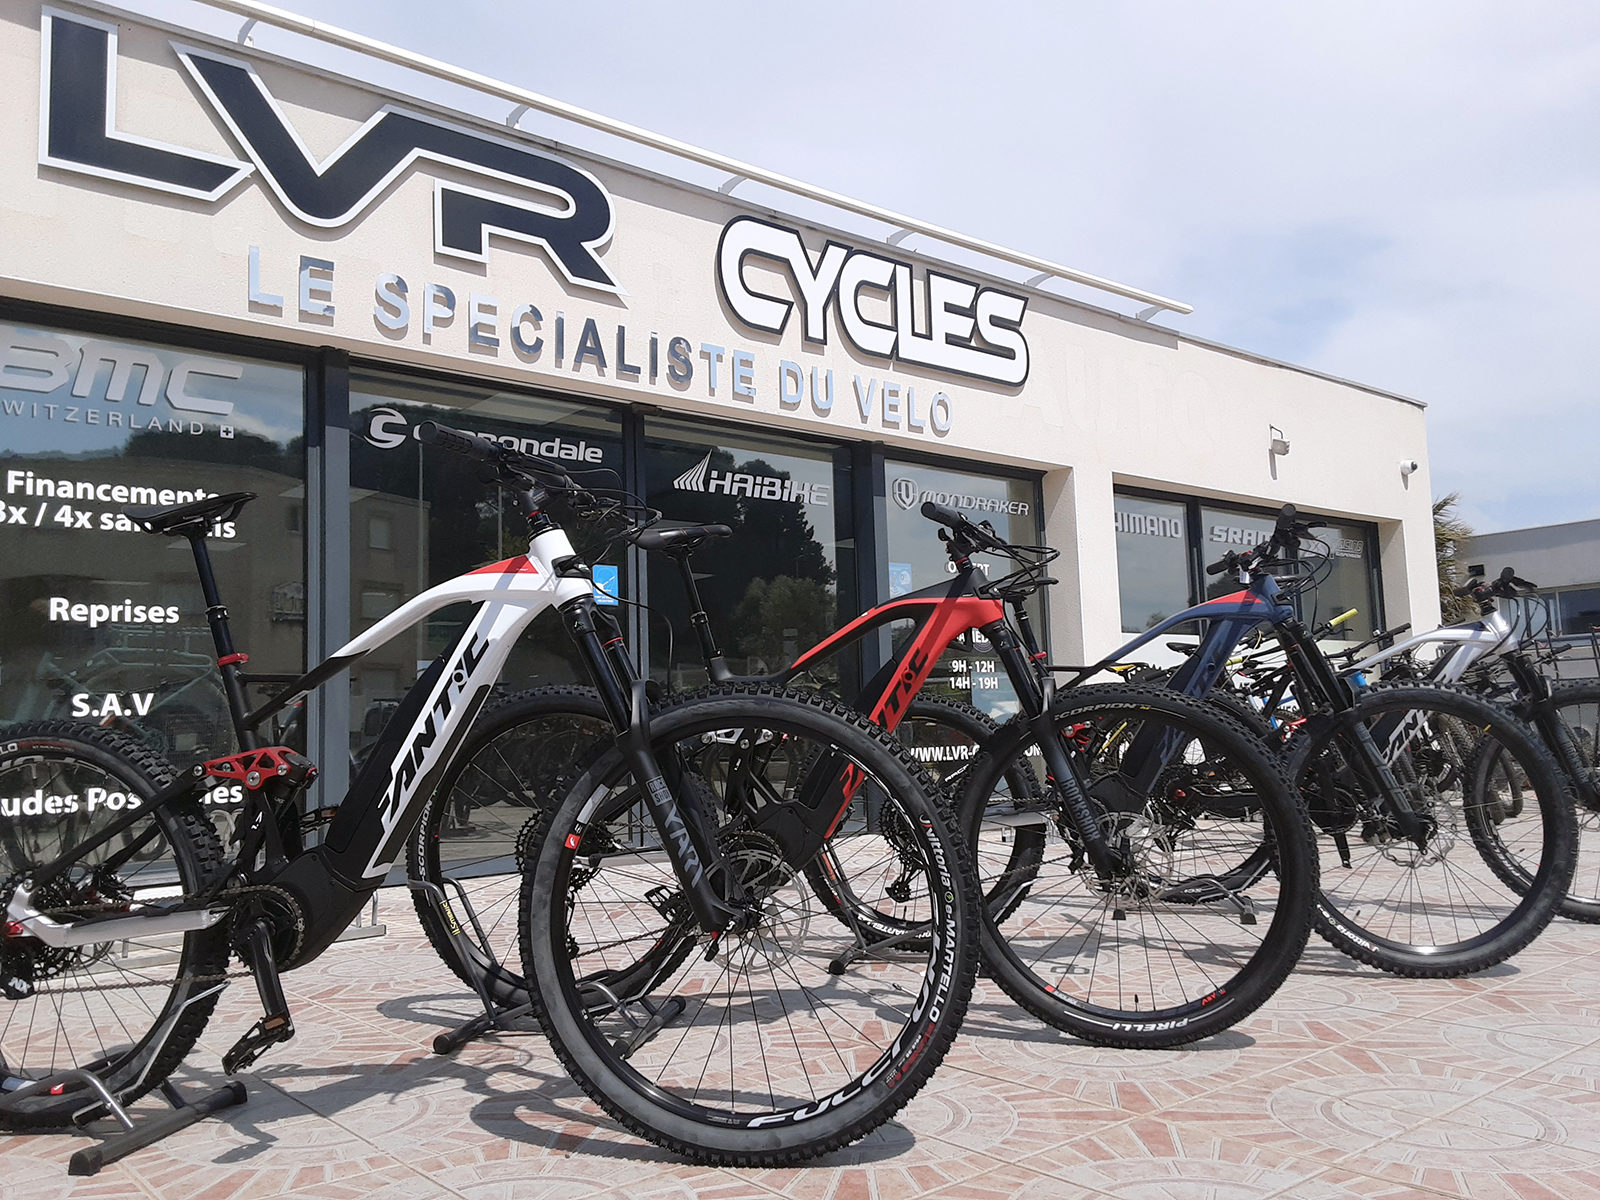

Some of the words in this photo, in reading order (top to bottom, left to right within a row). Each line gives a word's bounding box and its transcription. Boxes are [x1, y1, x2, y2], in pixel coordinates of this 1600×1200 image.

[38, 6, 629, 296] LVR
[717, 214, 1030, 388] CYCLES
[248, 245, 336, 317] LE
[373, 273, 757, 396] SPECIALISTE
[780, 359, 835, 410] DU
[854, 374, 954, 432] VELO
[3, 399, 205, 436] WITZERLAND
[53, 504, 93, 529] 4x
[919, 490, 1030, 516] MONDRAKER
[1115, 511, 1182, 538] HIMANO
[50, 597, 180, 628] Reprises
[951, 659, 967, 673] 9H
[974, 660, 995, 673] 12H
[950, 676, 971, 690] 14H
[978, 677, 999, 690] 19H
[71, 692, 155, 717] S.A.V
[0, 789, 79, 817] udes
[1111, 1017, 1190, 1032] PIRELLI
